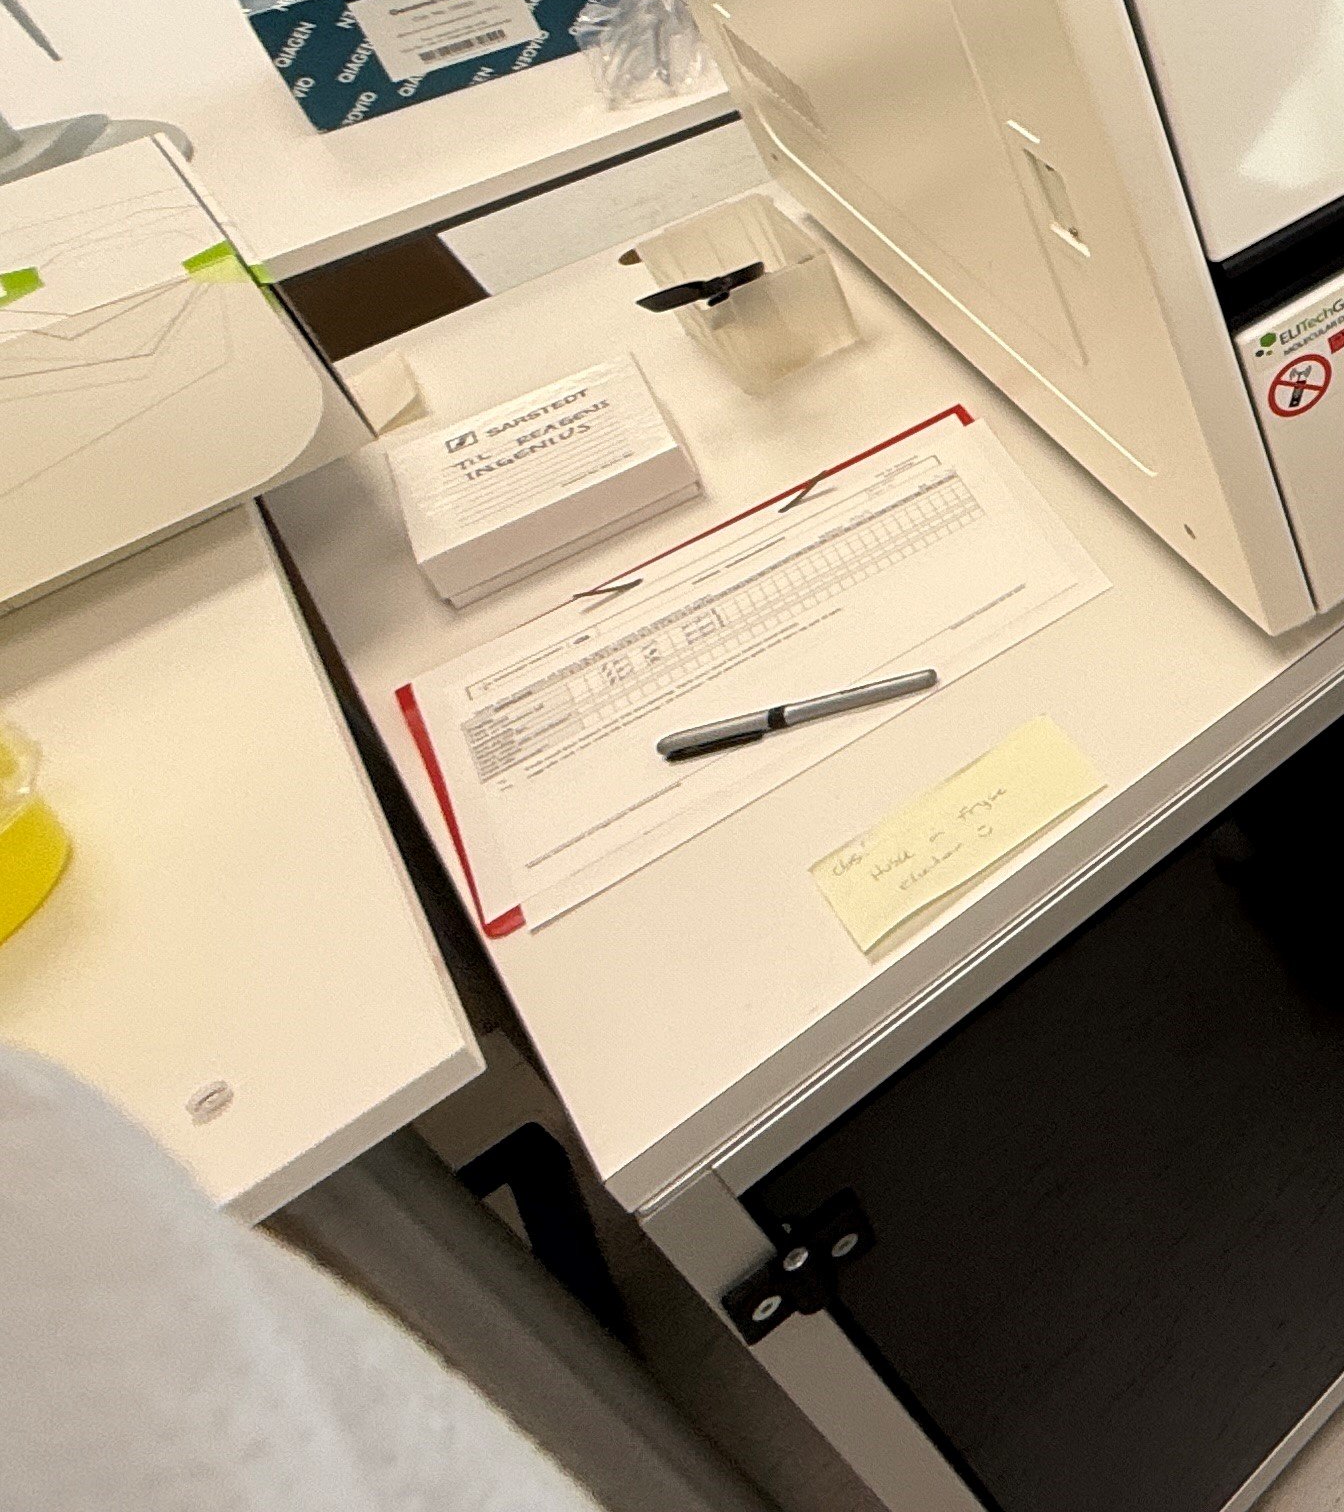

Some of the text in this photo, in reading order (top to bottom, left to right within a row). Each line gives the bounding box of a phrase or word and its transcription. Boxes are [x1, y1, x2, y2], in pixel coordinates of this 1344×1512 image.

[274, 21, 317, 68] QIAGEN
[485, 388, 589, 438] SARSTEDT
[452, 449, 493, 472] TIL
[464, 422, 593, 482] INGENIUS
